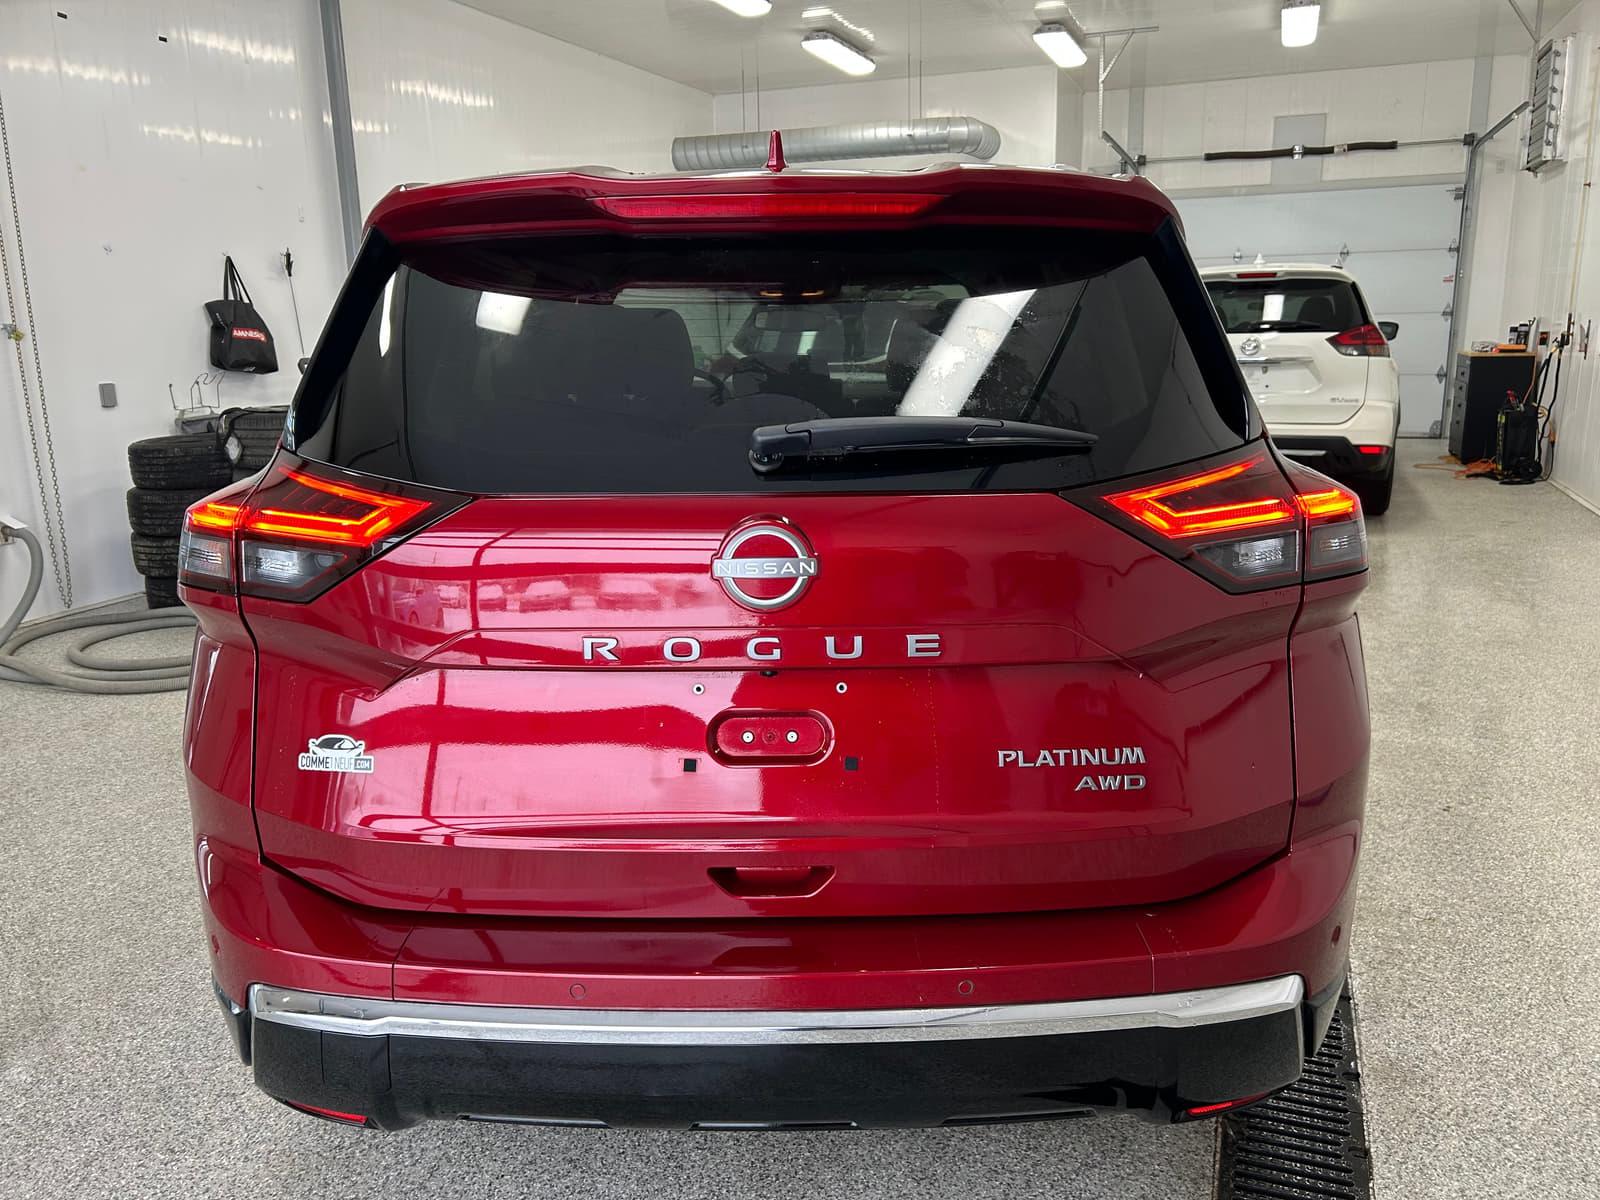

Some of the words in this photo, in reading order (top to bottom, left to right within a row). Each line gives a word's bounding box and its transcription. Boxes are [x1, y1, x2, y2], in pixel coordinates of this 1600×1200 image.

[717, 561, 815, 575] NISSAN
[582, 634, 943, 662] ROGUE
[998, 747, 1146, 767] PLATINUM
[1075, 775, 1146, 791] AWD
